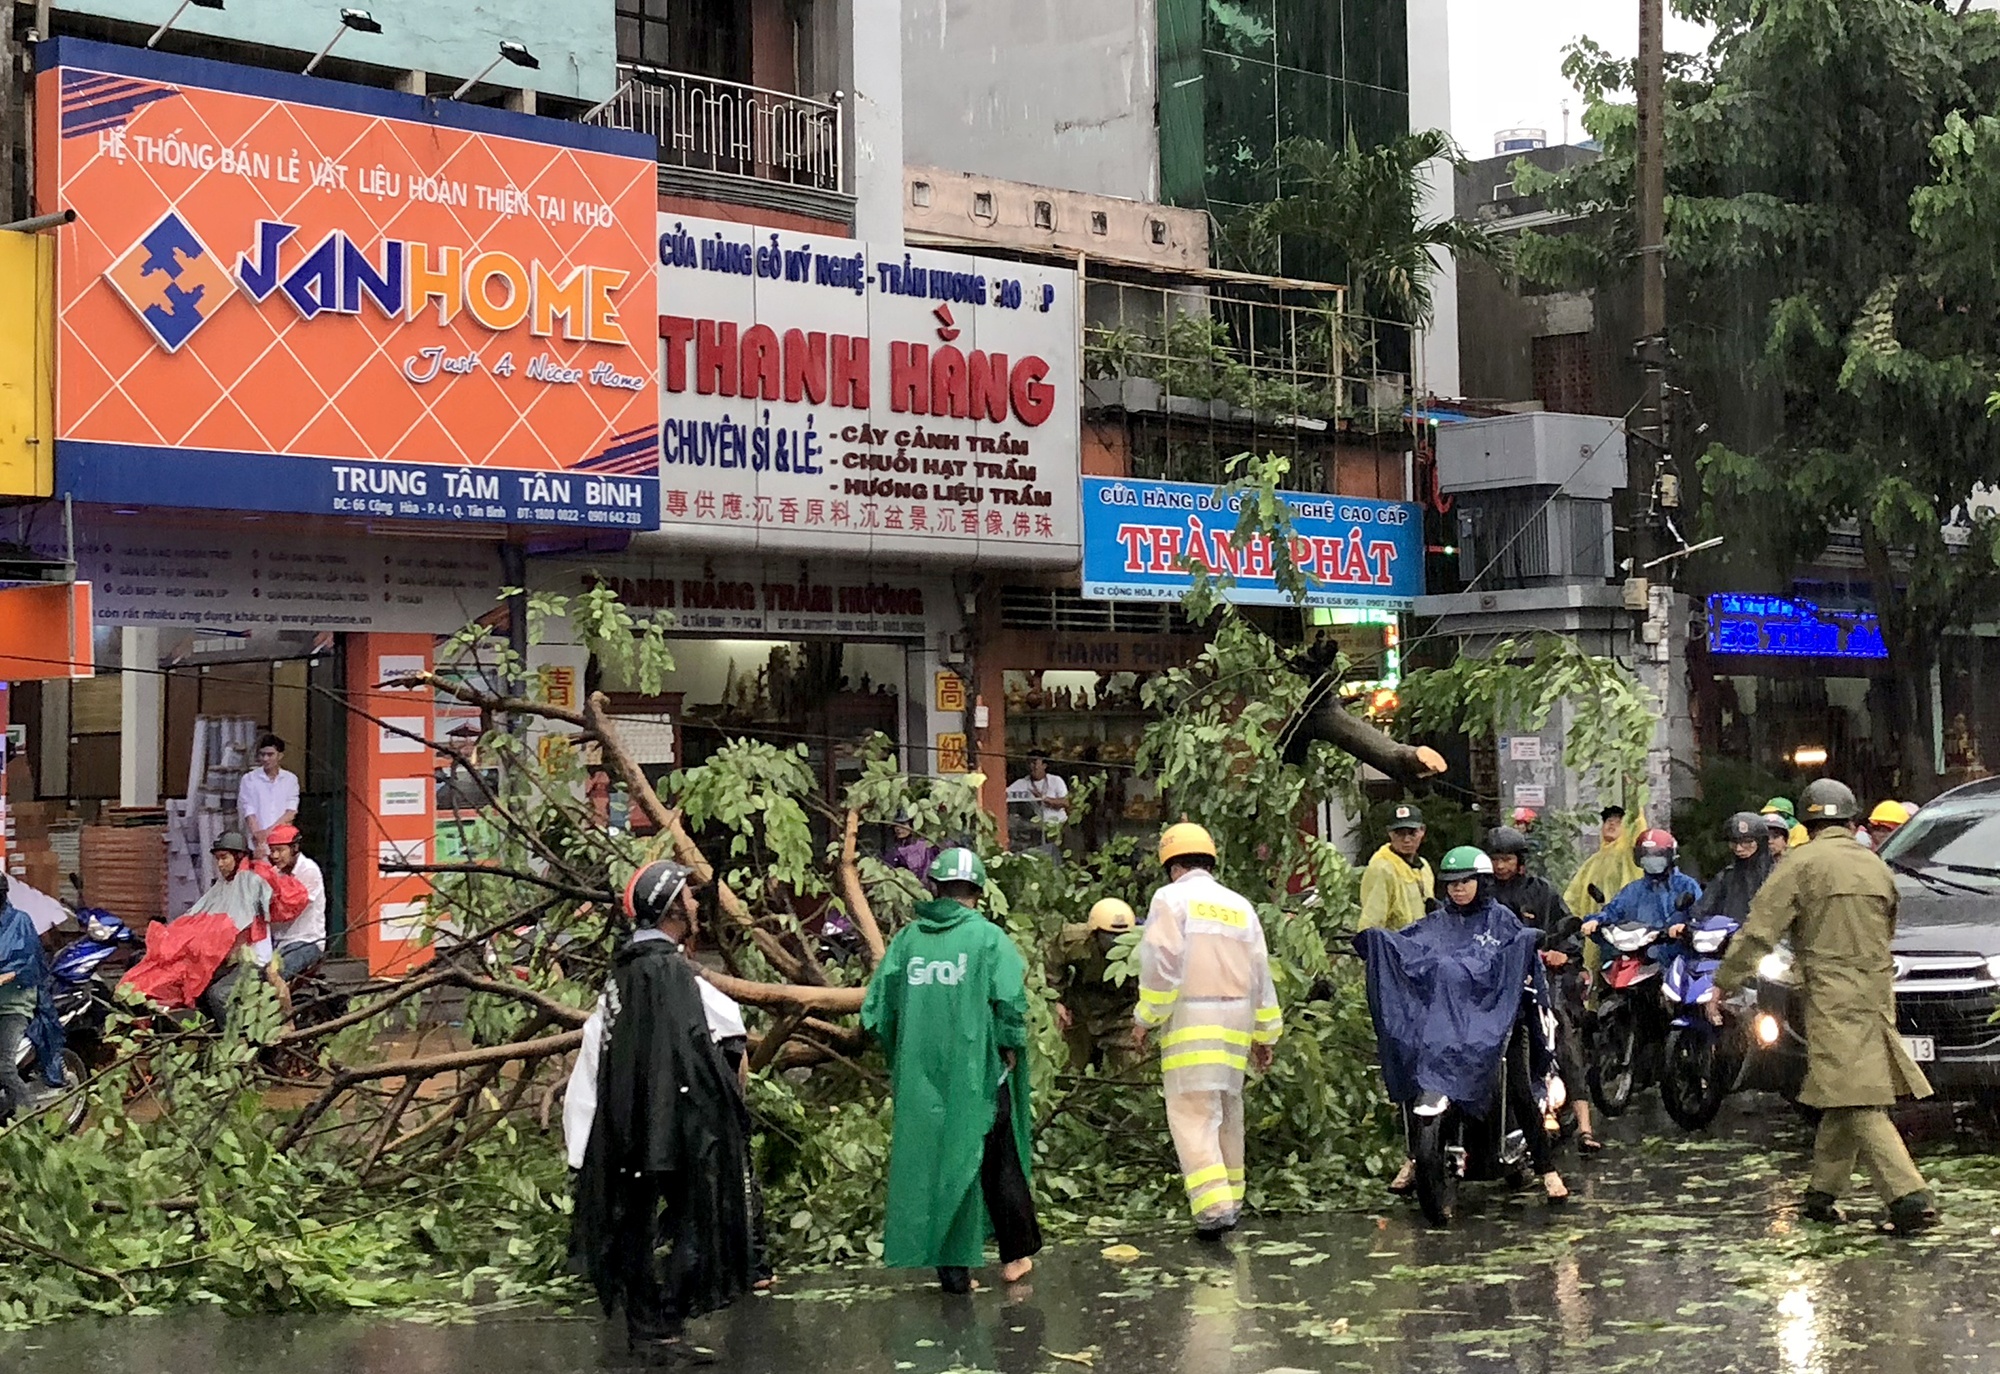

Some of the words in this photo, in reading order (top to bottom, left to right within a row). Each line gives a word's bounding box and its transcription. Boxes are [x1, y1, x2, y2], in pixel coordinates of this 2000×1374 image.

[98, 125, 126, 165] HỆ
[133, 128, 213, 170] THỐNG
[220, 142, 271, 179] BÁN
[276, 148, 300, 183] LẺ
[308, 156, 348, 193] VẬT
[358, 163, 400, 201] LIỆU
[408, 173, 468, 207] HOÀN
[474, 183, 529, 220] THIỆN
[537, 194, 566, 226] TẠI
[573, 200, 614, 228] KHO
[659, 222, 697, 269] CỬA
[701, 232, 752, 276] HÀNG
[757, 233, 781, 279] GỖ
[815, 252, 865, 296] NGHỆ
[404, 346, 479, 384] Just
[491, 353, 516, 378] A
[526, 354, 583, 384] Nicer
[587, 362, 644, 392] Home
[658, 314, 869, 409] THANH
[890, 303, 1055, 427] HẰNG
[663, 414, 746, 469] CHUYÊN
[752, 408, 770, 472] SỈ
[775, 428, 789, 472] &
[841, 423, 888, 446] CÂY
[895, 425, 960, 450] CẢNH
[842, 448, 917, 473] CHUỖI
[923, 458, 967, 479] HẠT
[332, 466, 427, 496] TRUNG
[443, 467, 499, 500] TÂM
[518, 472, 570, 504] TÂN
[585, 475, 642, 508] BÌNH
[353, 499, 365, 511] 66
[844, 477, 928, 500] HƯƠNG
[933, 482, 983, 505] LIỆU
[1100, 483, 1137, 506] CỬA
[1143, 485, 1192, 510] HÀNG
[1340, 505, 1372, 523] CAO
[1376, 503, 1409, 525] CẤP
[1116, 514, 1277, 579] THÀNH
[1288, 526, 1398, 586] PHÁT
[1107, 585, 1132, 597] CỘNG
[939, 673, 962, 708] 高
